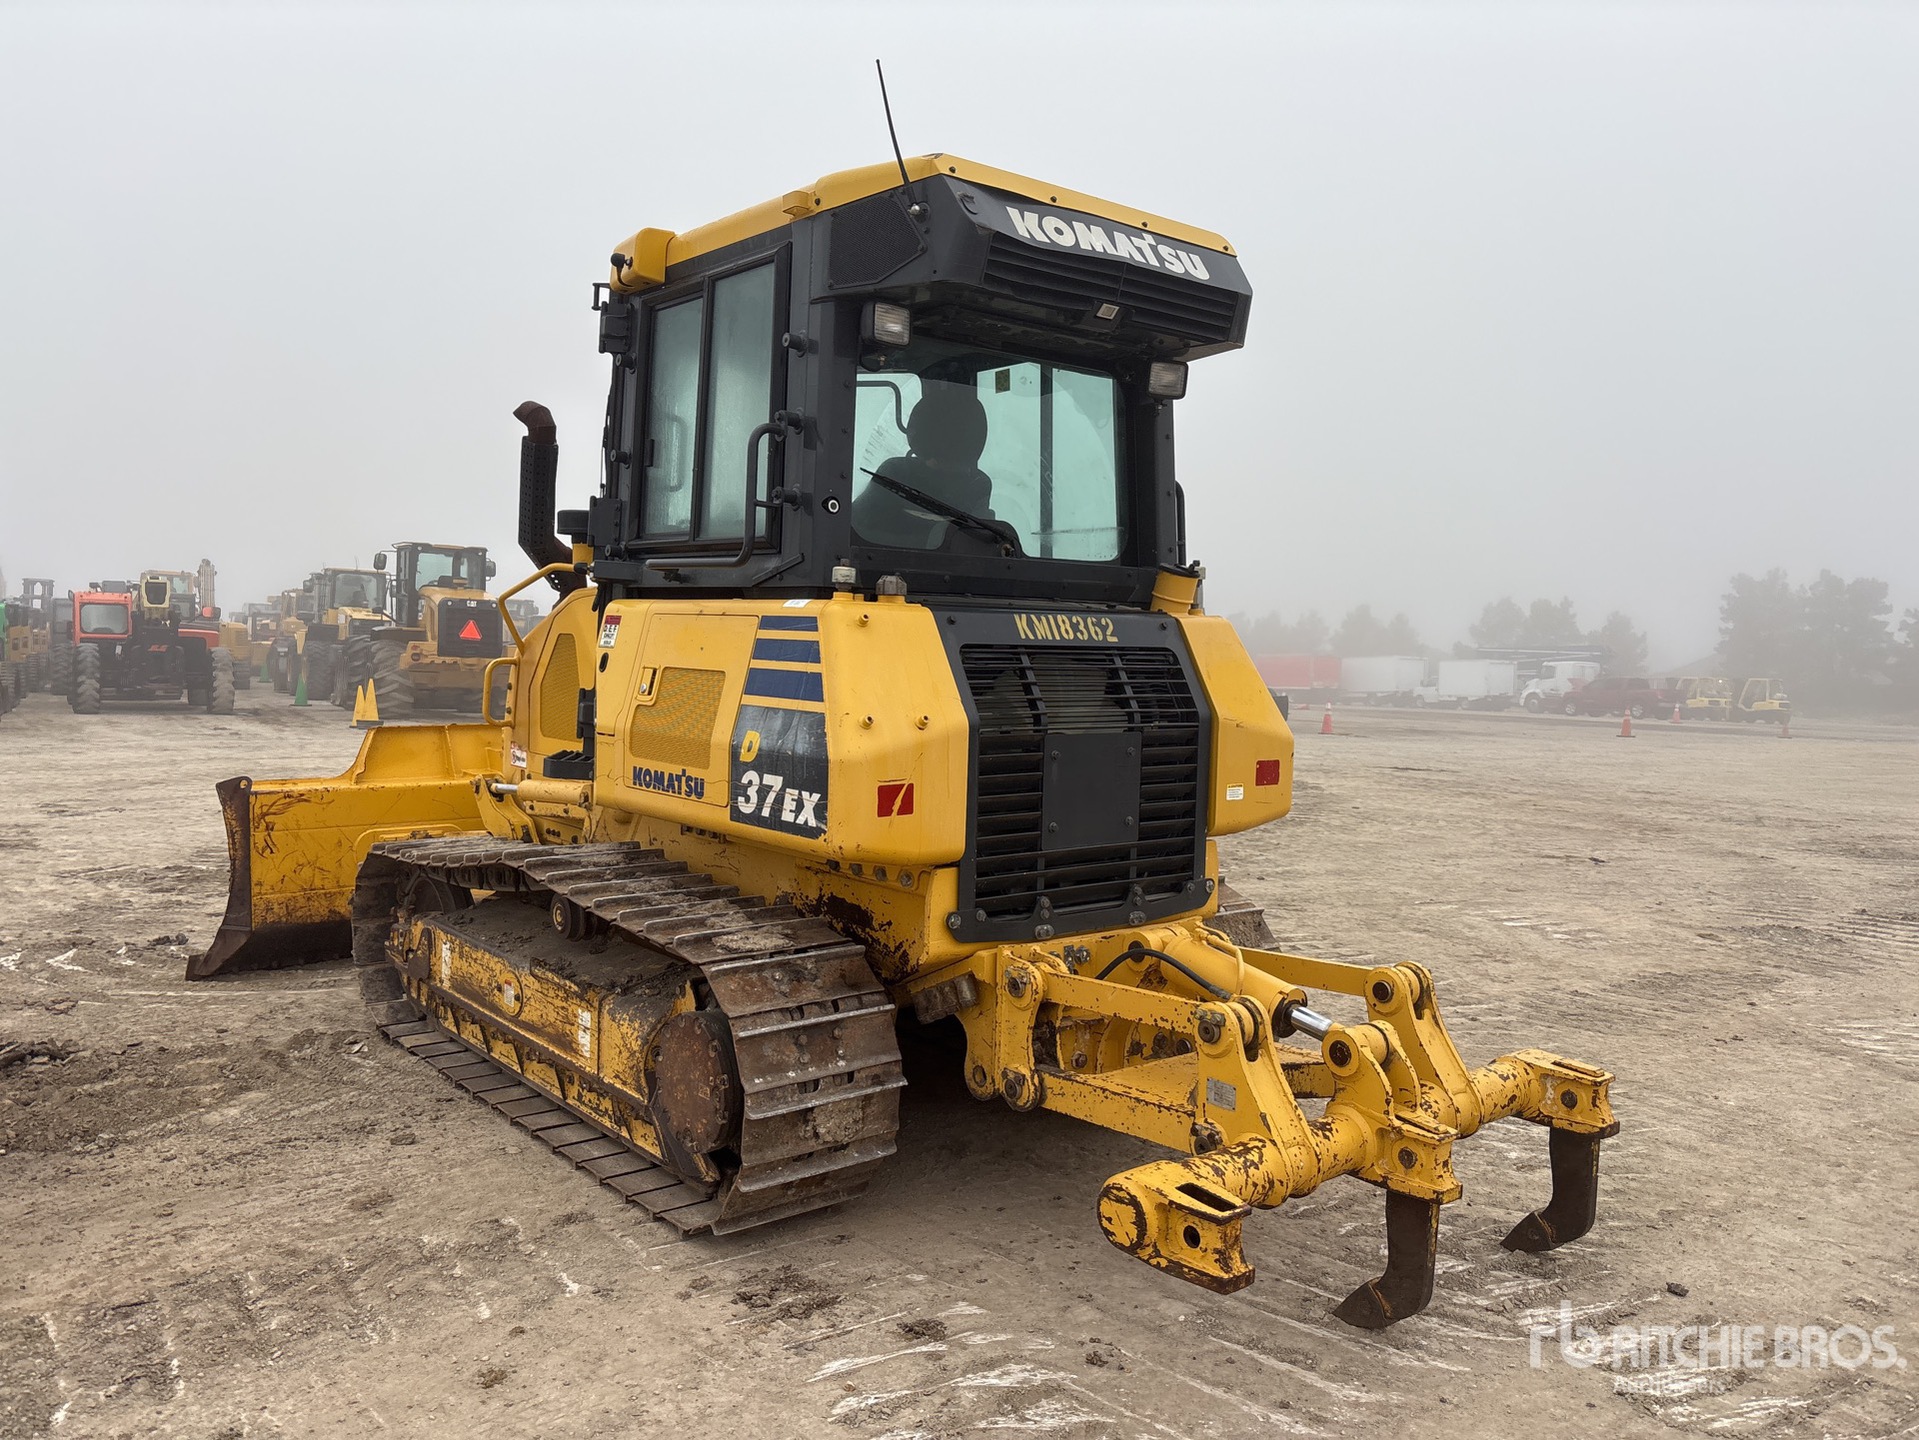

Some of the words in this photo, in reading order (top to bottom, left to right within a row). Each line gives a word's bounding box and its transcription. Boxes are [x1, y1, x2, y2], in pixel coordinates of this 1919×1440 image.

[1005, 205, 1210, 281] KOMATSU
[740, 730, 760, 763] D
[632, 766, 705, 800] KOMATSU
[737, 770, 821, 827] 37EX
